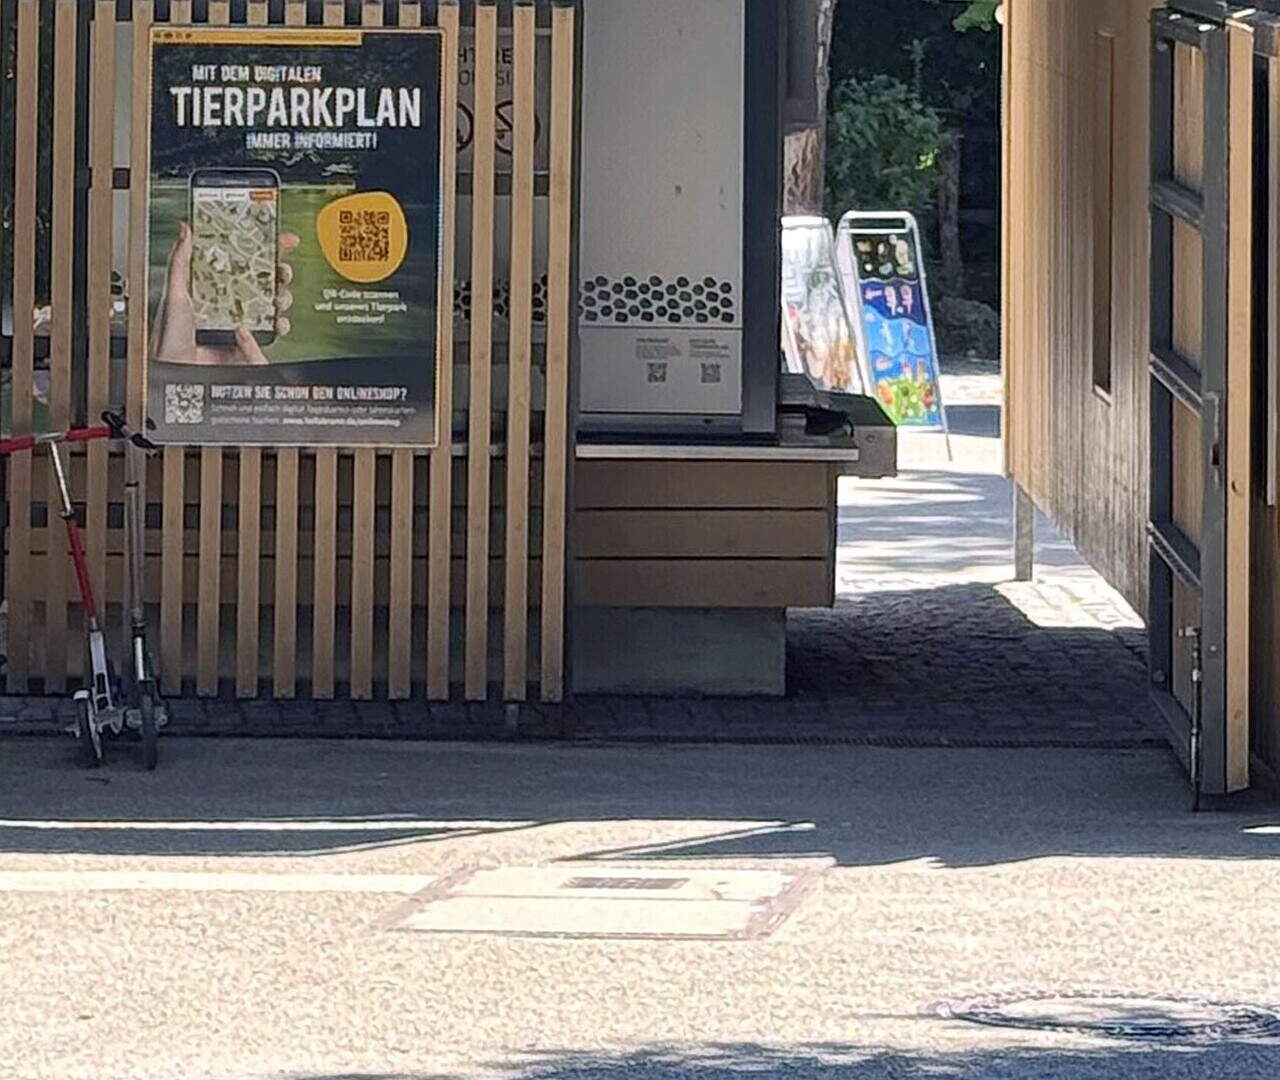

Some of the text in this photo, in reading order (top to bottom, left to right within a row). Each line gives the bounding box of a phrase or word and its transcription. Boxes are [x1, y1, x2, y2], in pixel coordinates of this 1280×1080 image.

[192, 65, 322, 82] MIT DEM DIGITALEN
[170, 86, 420, 127] TIERPARKPLAN
[246, 133, 378, 150] IMMER INFORMIERT!
